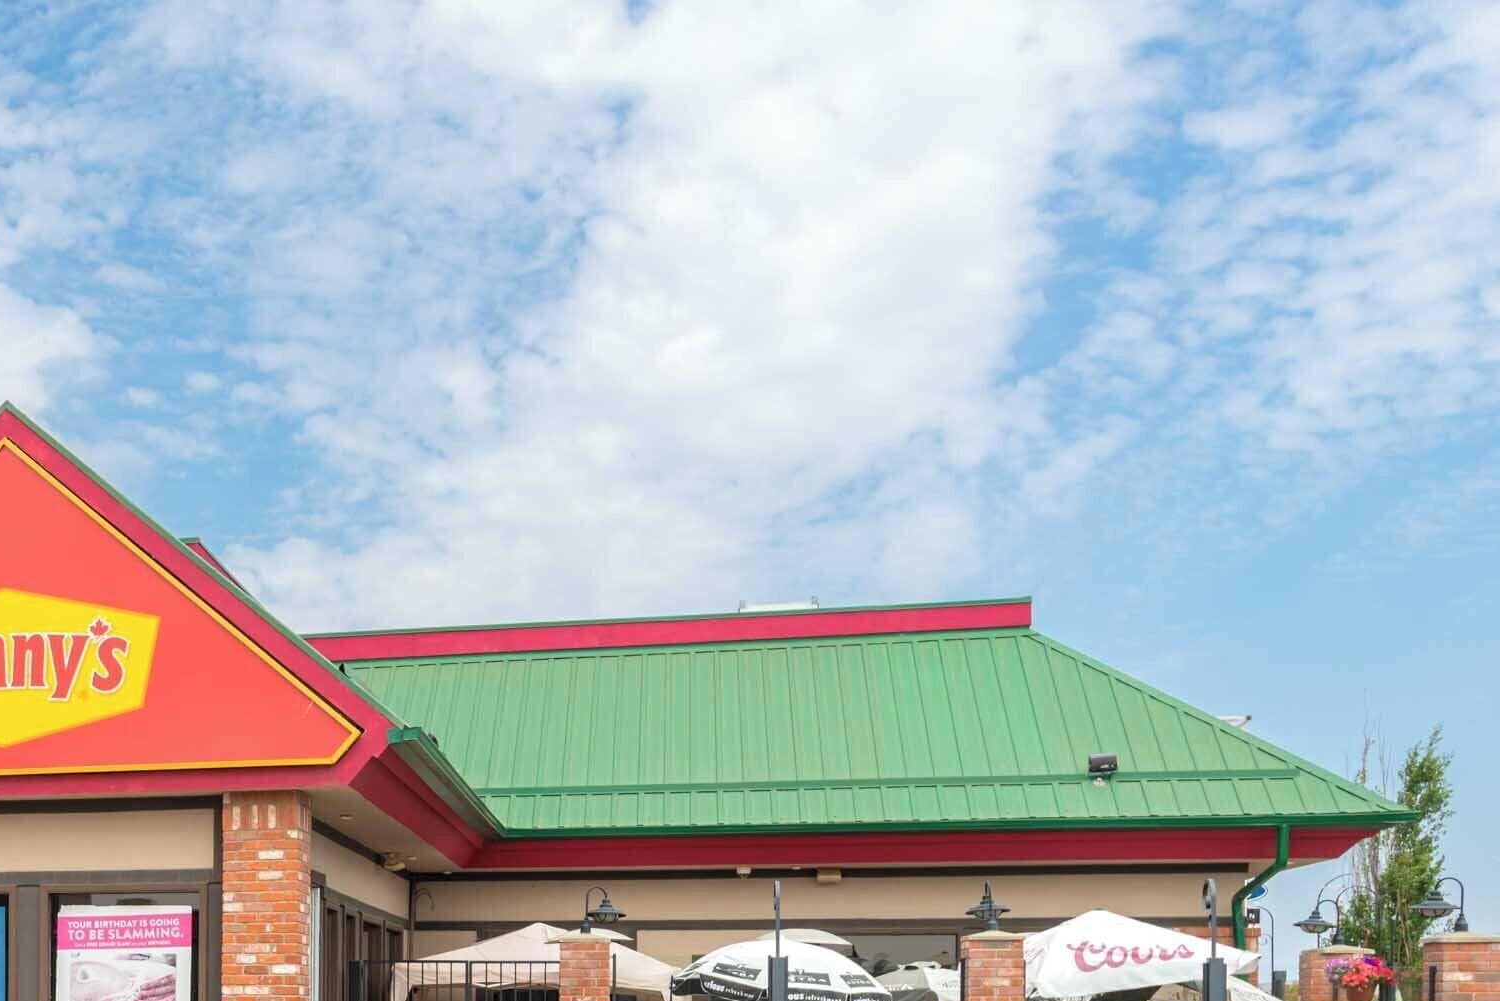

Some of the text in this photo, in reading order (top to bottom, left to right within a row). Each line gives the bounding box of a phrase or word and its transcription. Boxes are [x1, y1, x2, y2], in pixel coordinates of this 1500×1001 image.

[67, 918, 180, 929] YOUR BIRTHDAY IS GOING
[67, 929, 85, 941] TO
[89, 929, 105, 940] BE
